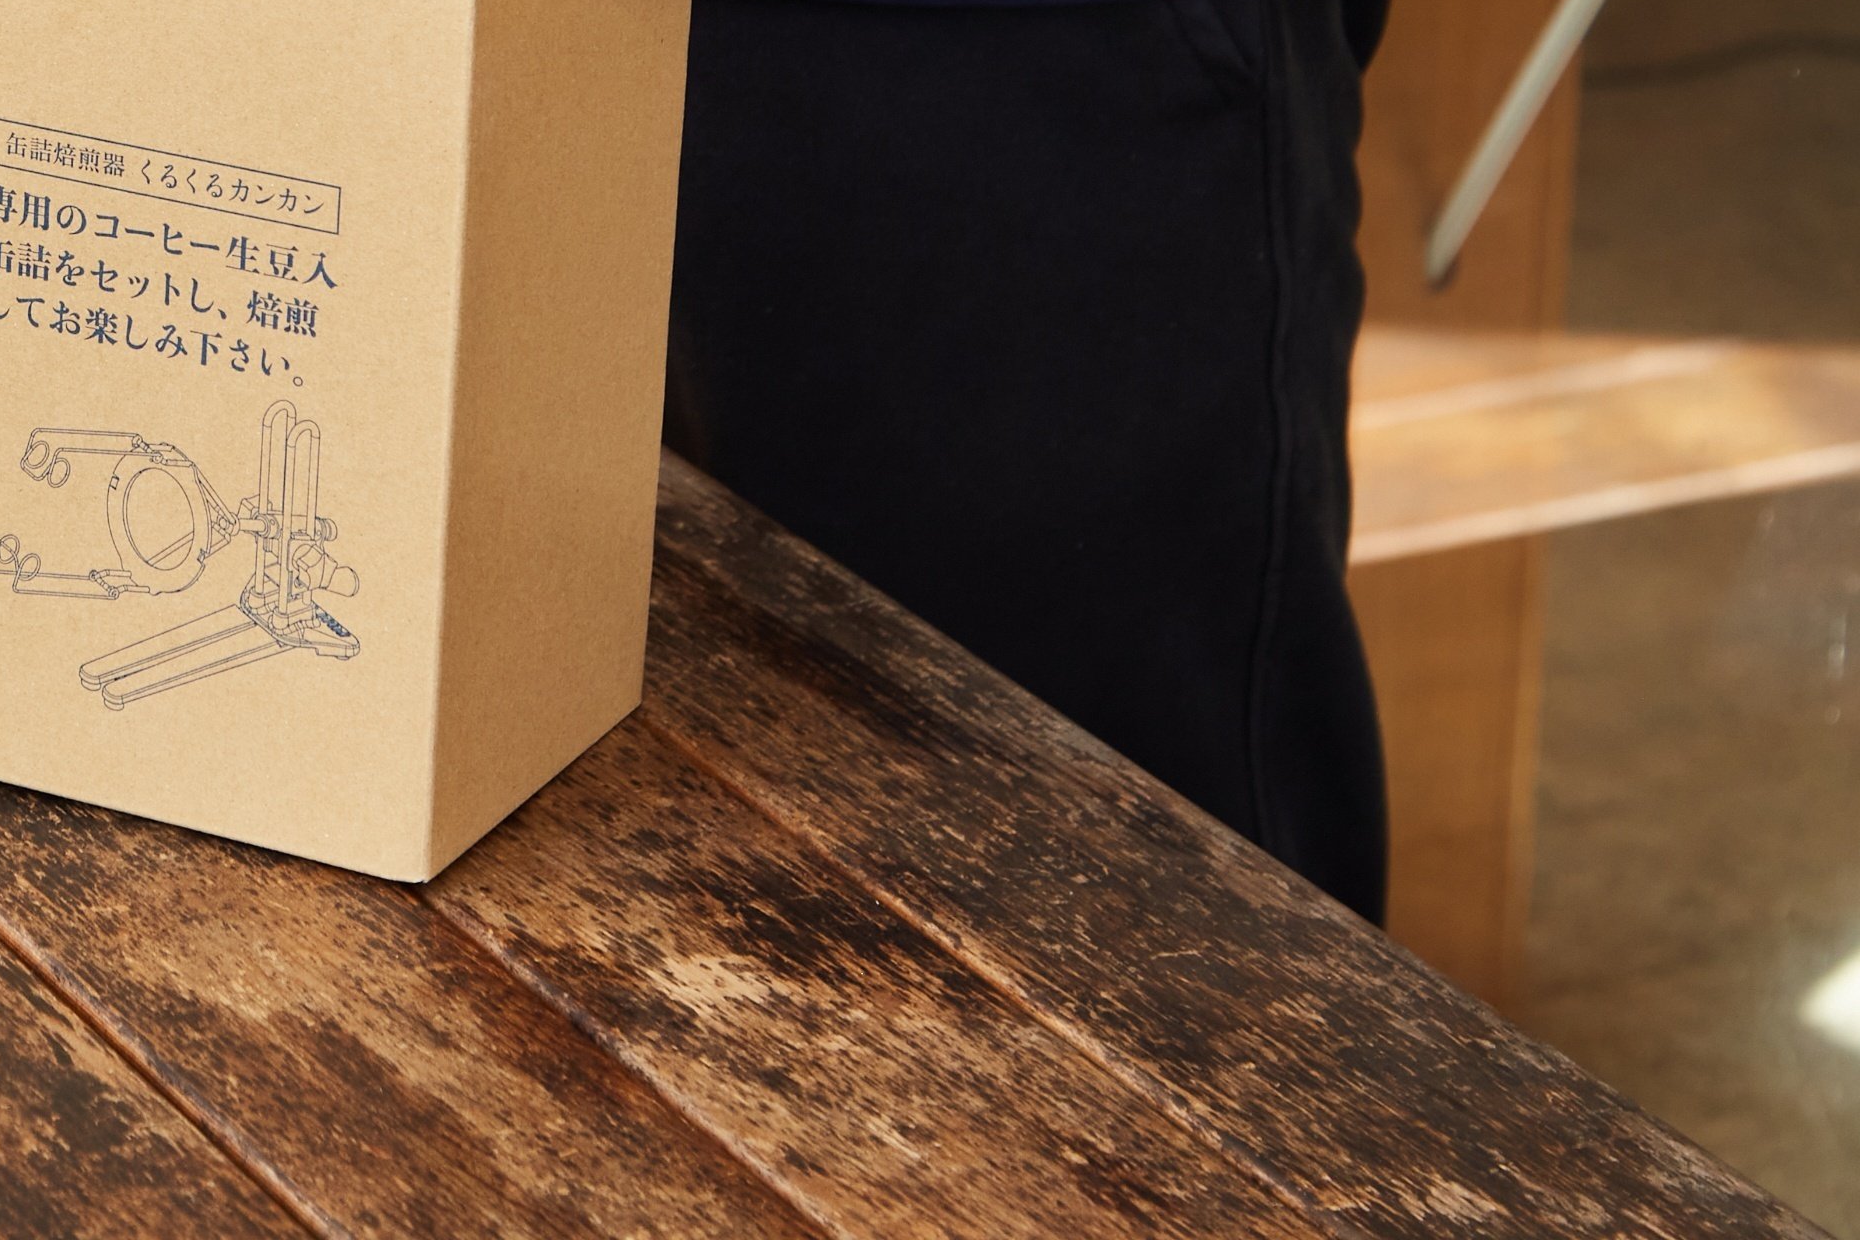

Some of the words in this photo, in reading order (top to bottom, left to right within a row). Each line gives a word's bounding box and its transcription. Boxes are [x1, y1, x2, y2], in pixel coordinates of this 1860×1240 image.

[6, 131, 125, 178] 缶詰焙煎器
[140, 158, 324, 215] くるくるカンカン
